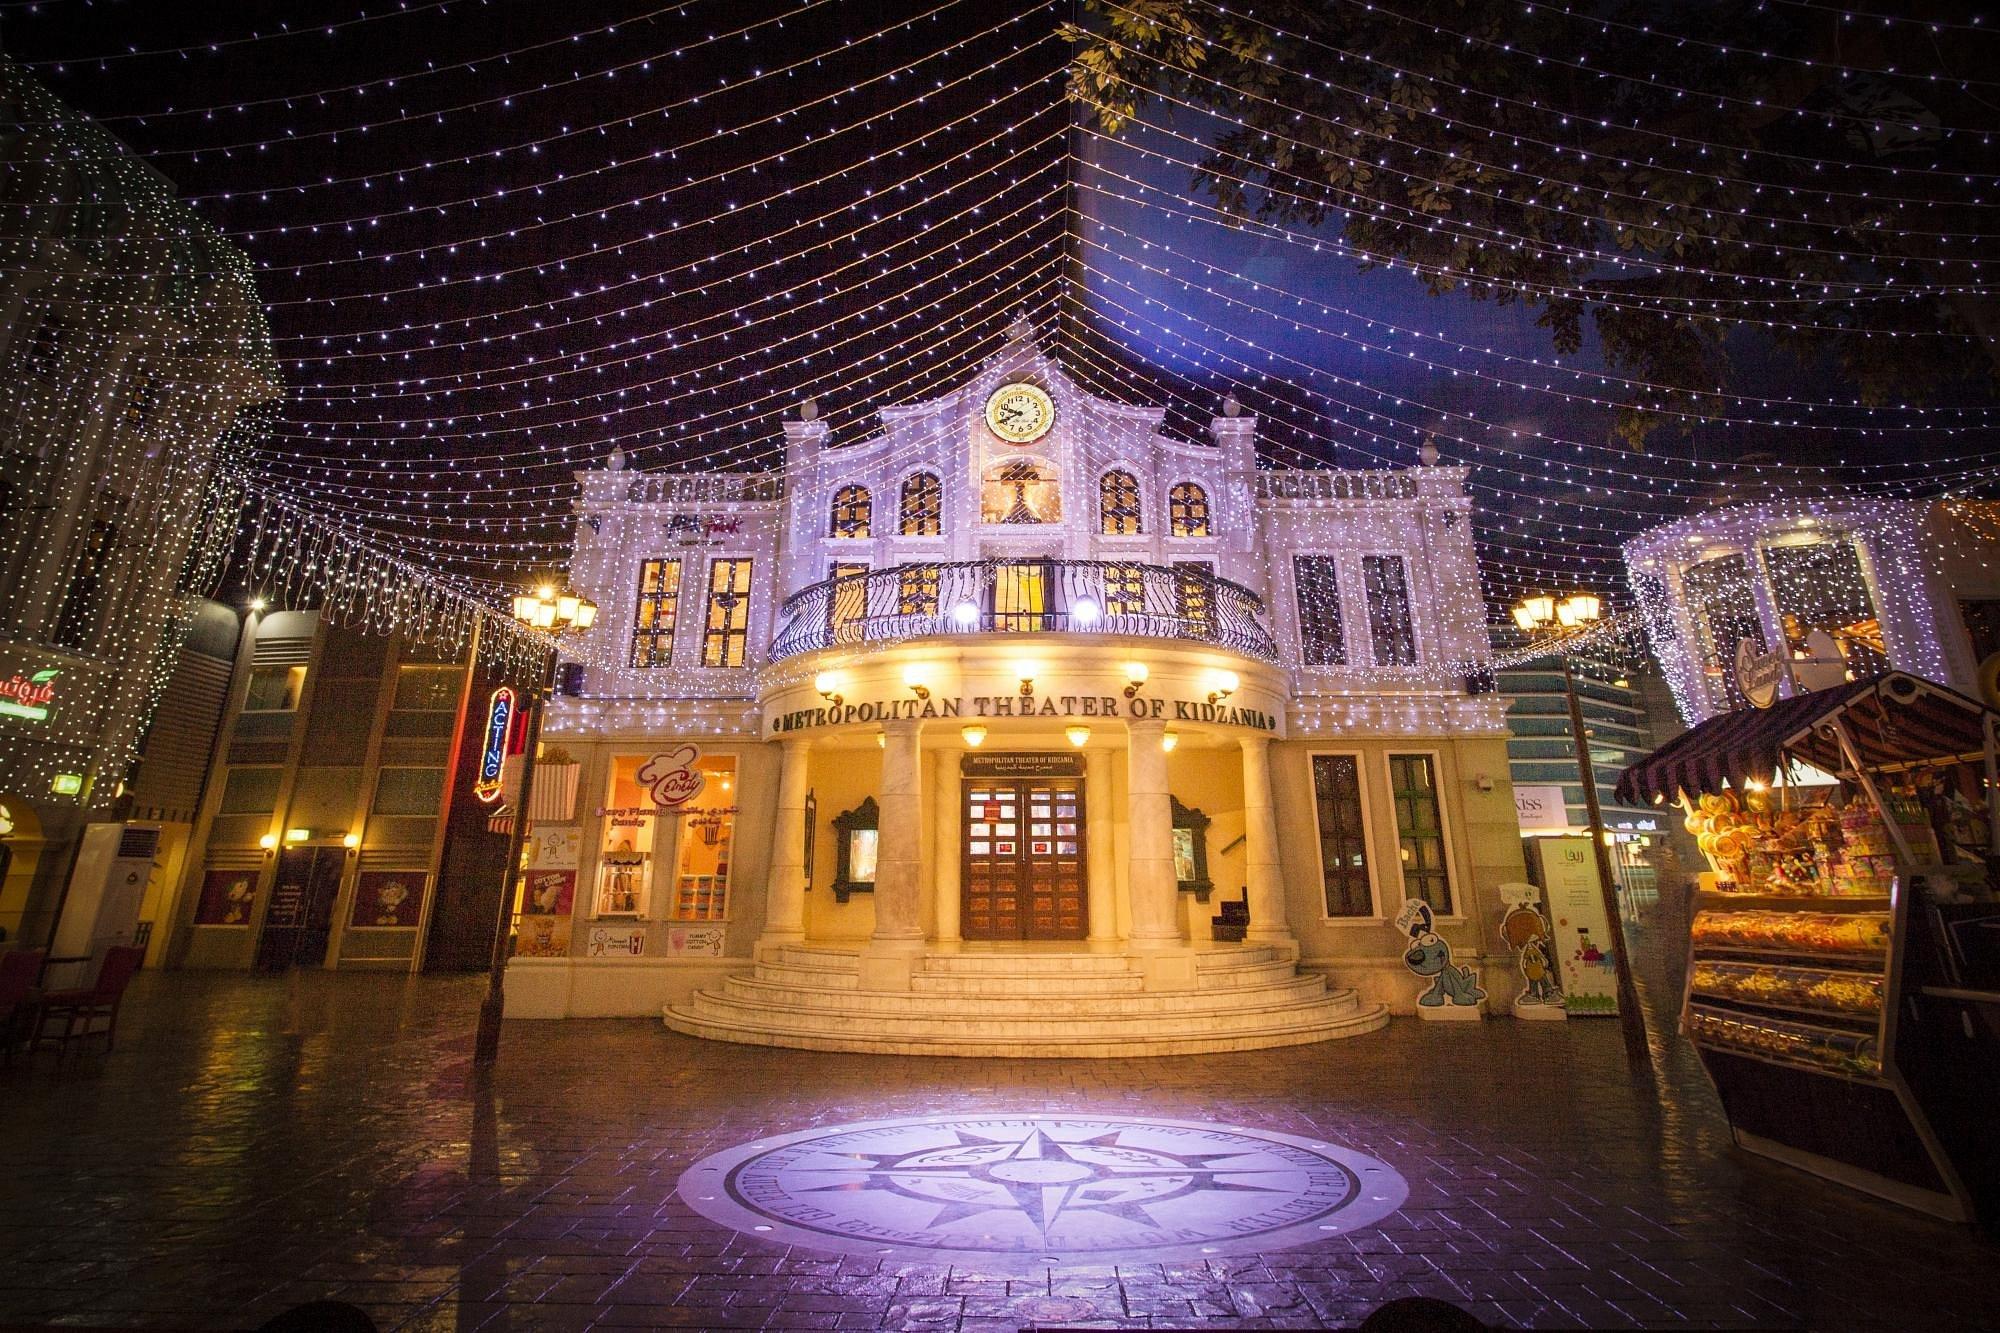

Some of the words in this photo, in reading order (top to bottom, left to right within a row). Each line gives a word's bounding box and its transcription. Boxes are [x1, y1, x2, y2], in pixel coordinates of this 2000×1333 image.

[782, 697, 961, 731] METROPOLITAN
[974, 696, 1119, 717] THEATER
[1129, 698, 1165, 718] OF
[1175, 701, 1268, 729] KIDZANIA
[485, 701, 508, 777] ACTING
[973, 756, 1014, 764] METROPOLITAN
[1014, 756, 1039, 764] THEATER
[1047, 756, 1074, 764] KIDZANIA
[650, 769, 701, 806] Candy
[534, 872, 561, 885] COTTON
[925, 1121, 1036, 1131] WORLD
[808, 1127, 907, 1147] BETTER
[1202, 1131, 1261, 1145] GET
[749, 1155, 801, 1170] FOR
[1254, 1144, 1333, 1168] READY
[742, 1173, 793, 1203] READY
[1305, 1171, 1347, 1188] FOR
[768, 1204, 836, 1221] GET
[1226, 1198, 1332, 1232] BETTER
